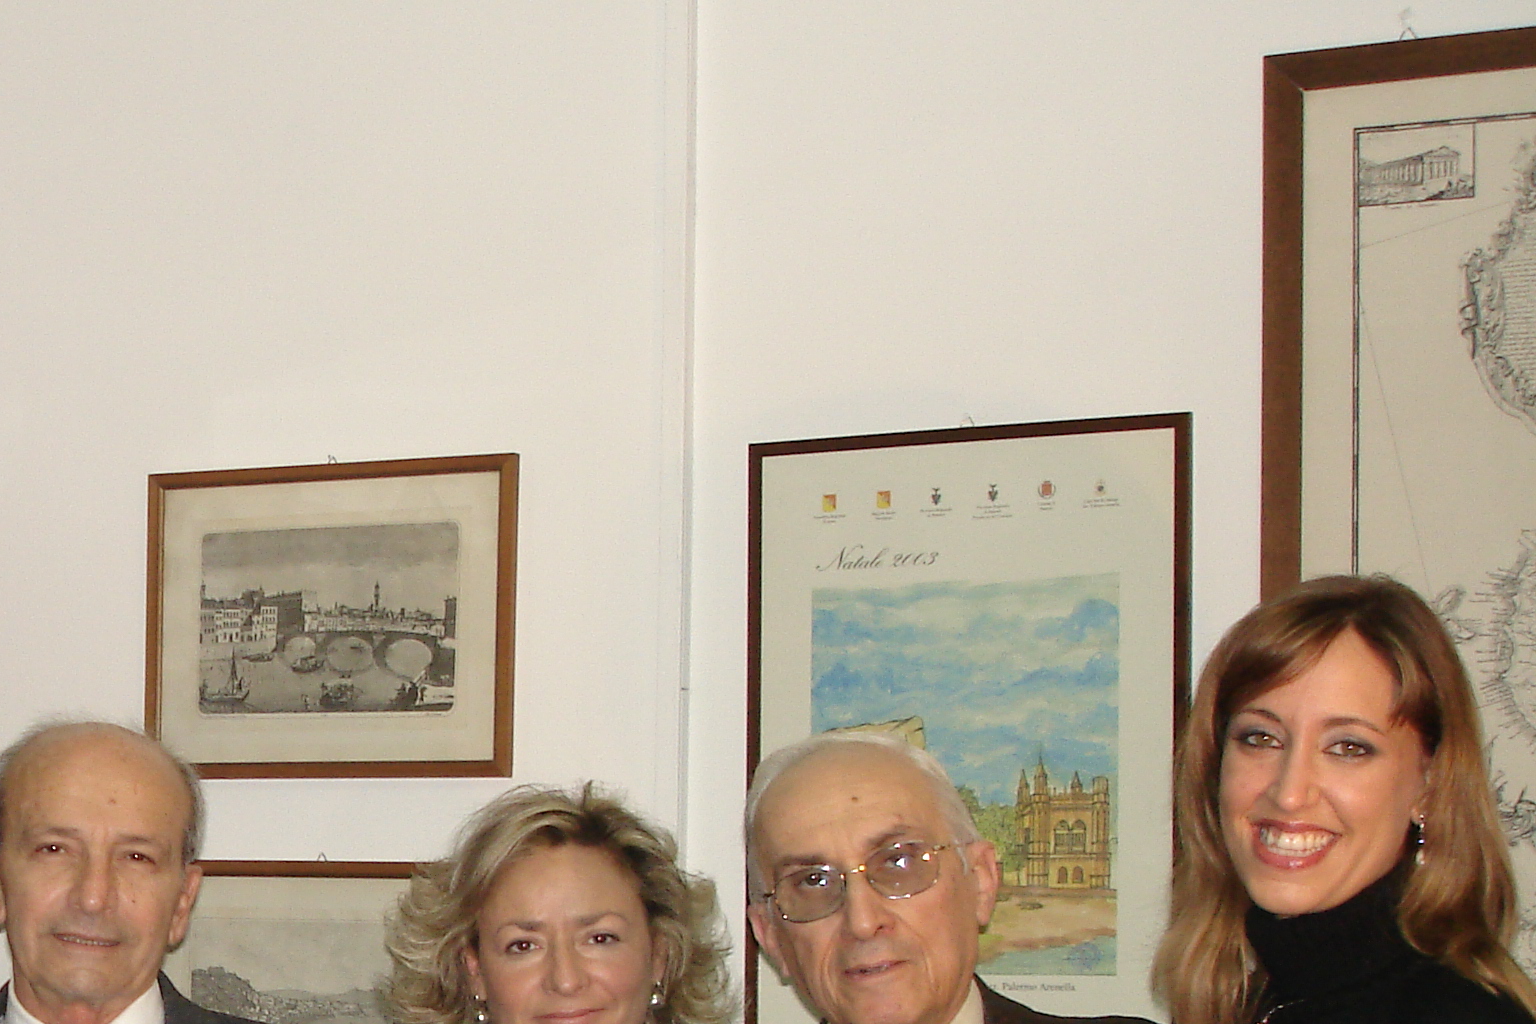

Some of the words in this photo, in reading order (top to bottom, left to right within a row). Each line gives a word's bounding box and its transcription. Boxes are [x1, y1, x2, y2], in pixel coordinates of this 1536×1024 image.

[815, 544, 888, 572] Natale
[892, 552, 939, 567] 2003
[1002, 981, 1037, 991] Palermo
